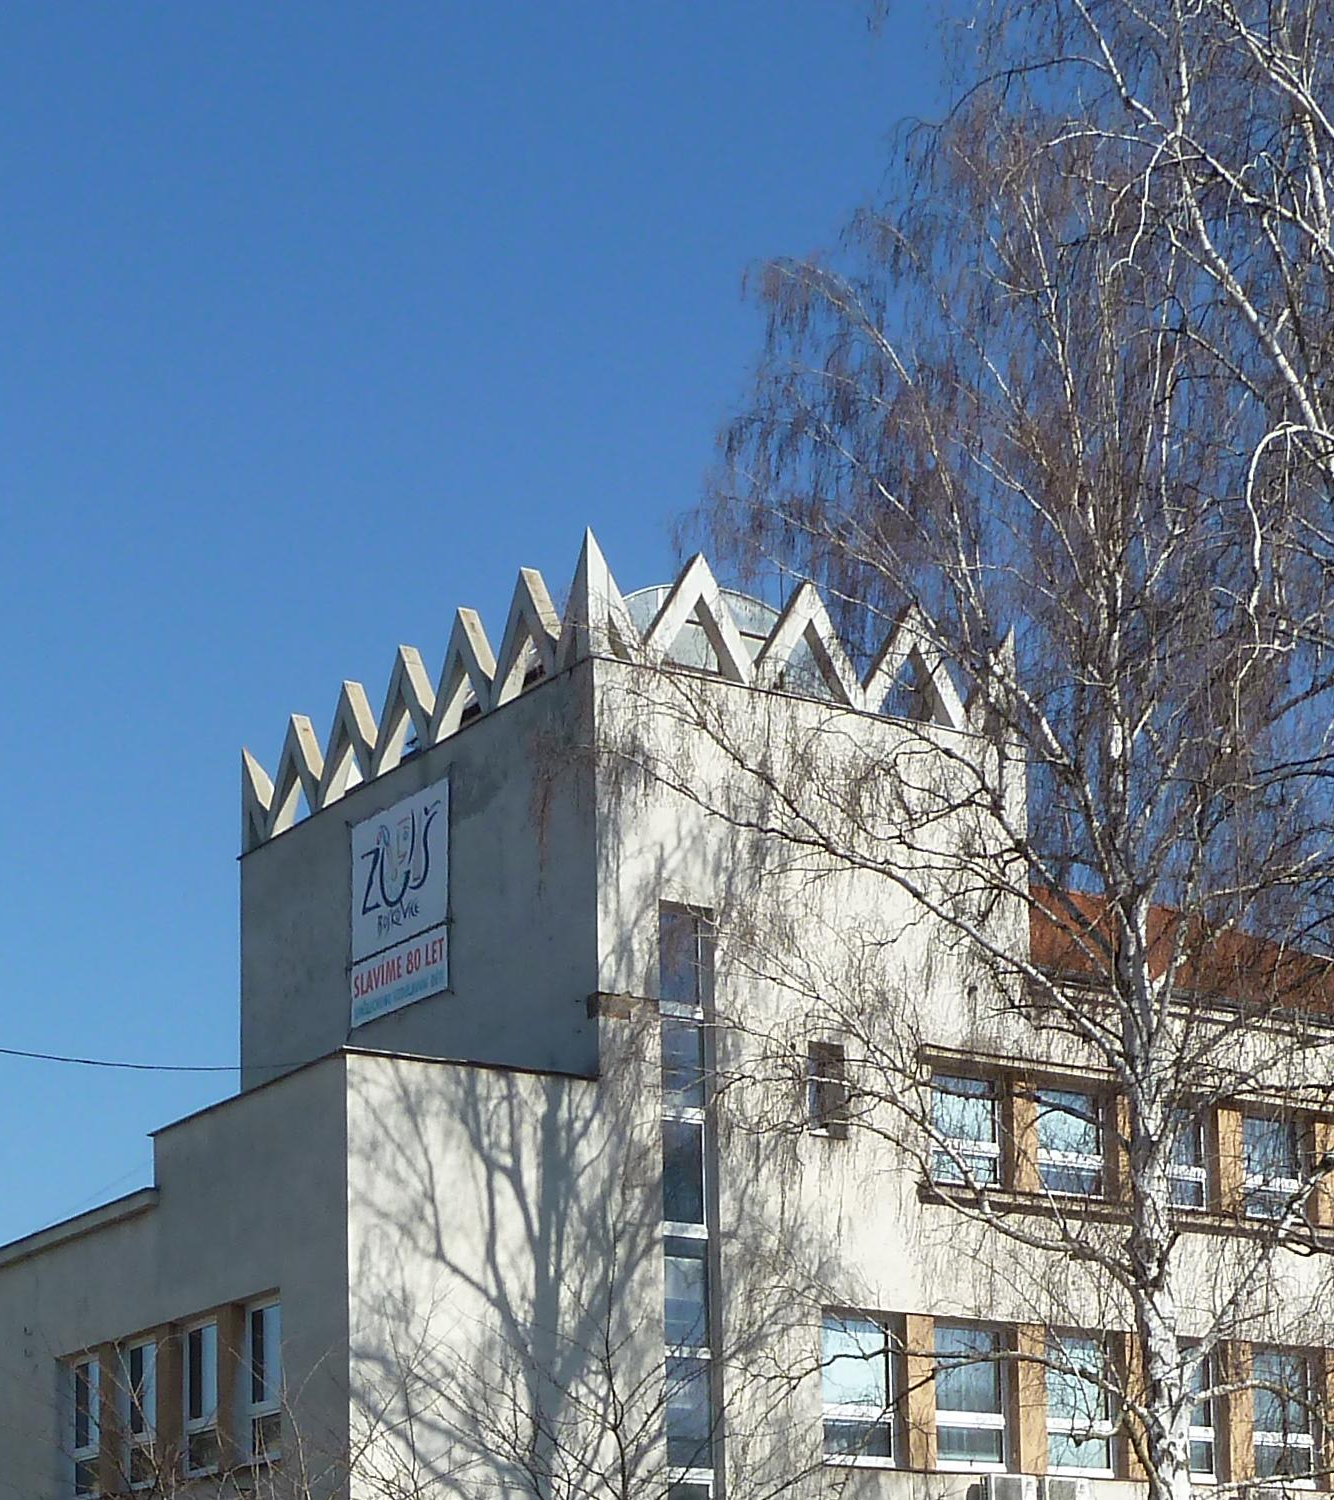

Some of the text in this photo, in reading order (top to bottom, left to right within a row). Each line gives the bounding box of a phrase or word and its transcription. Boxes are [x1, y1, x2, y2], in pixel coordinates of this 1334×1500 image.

[354, 955, 402, 998] SLAVÍME
[406, 948, 421, 975] 80
[425, 937, 444, 966] LET
